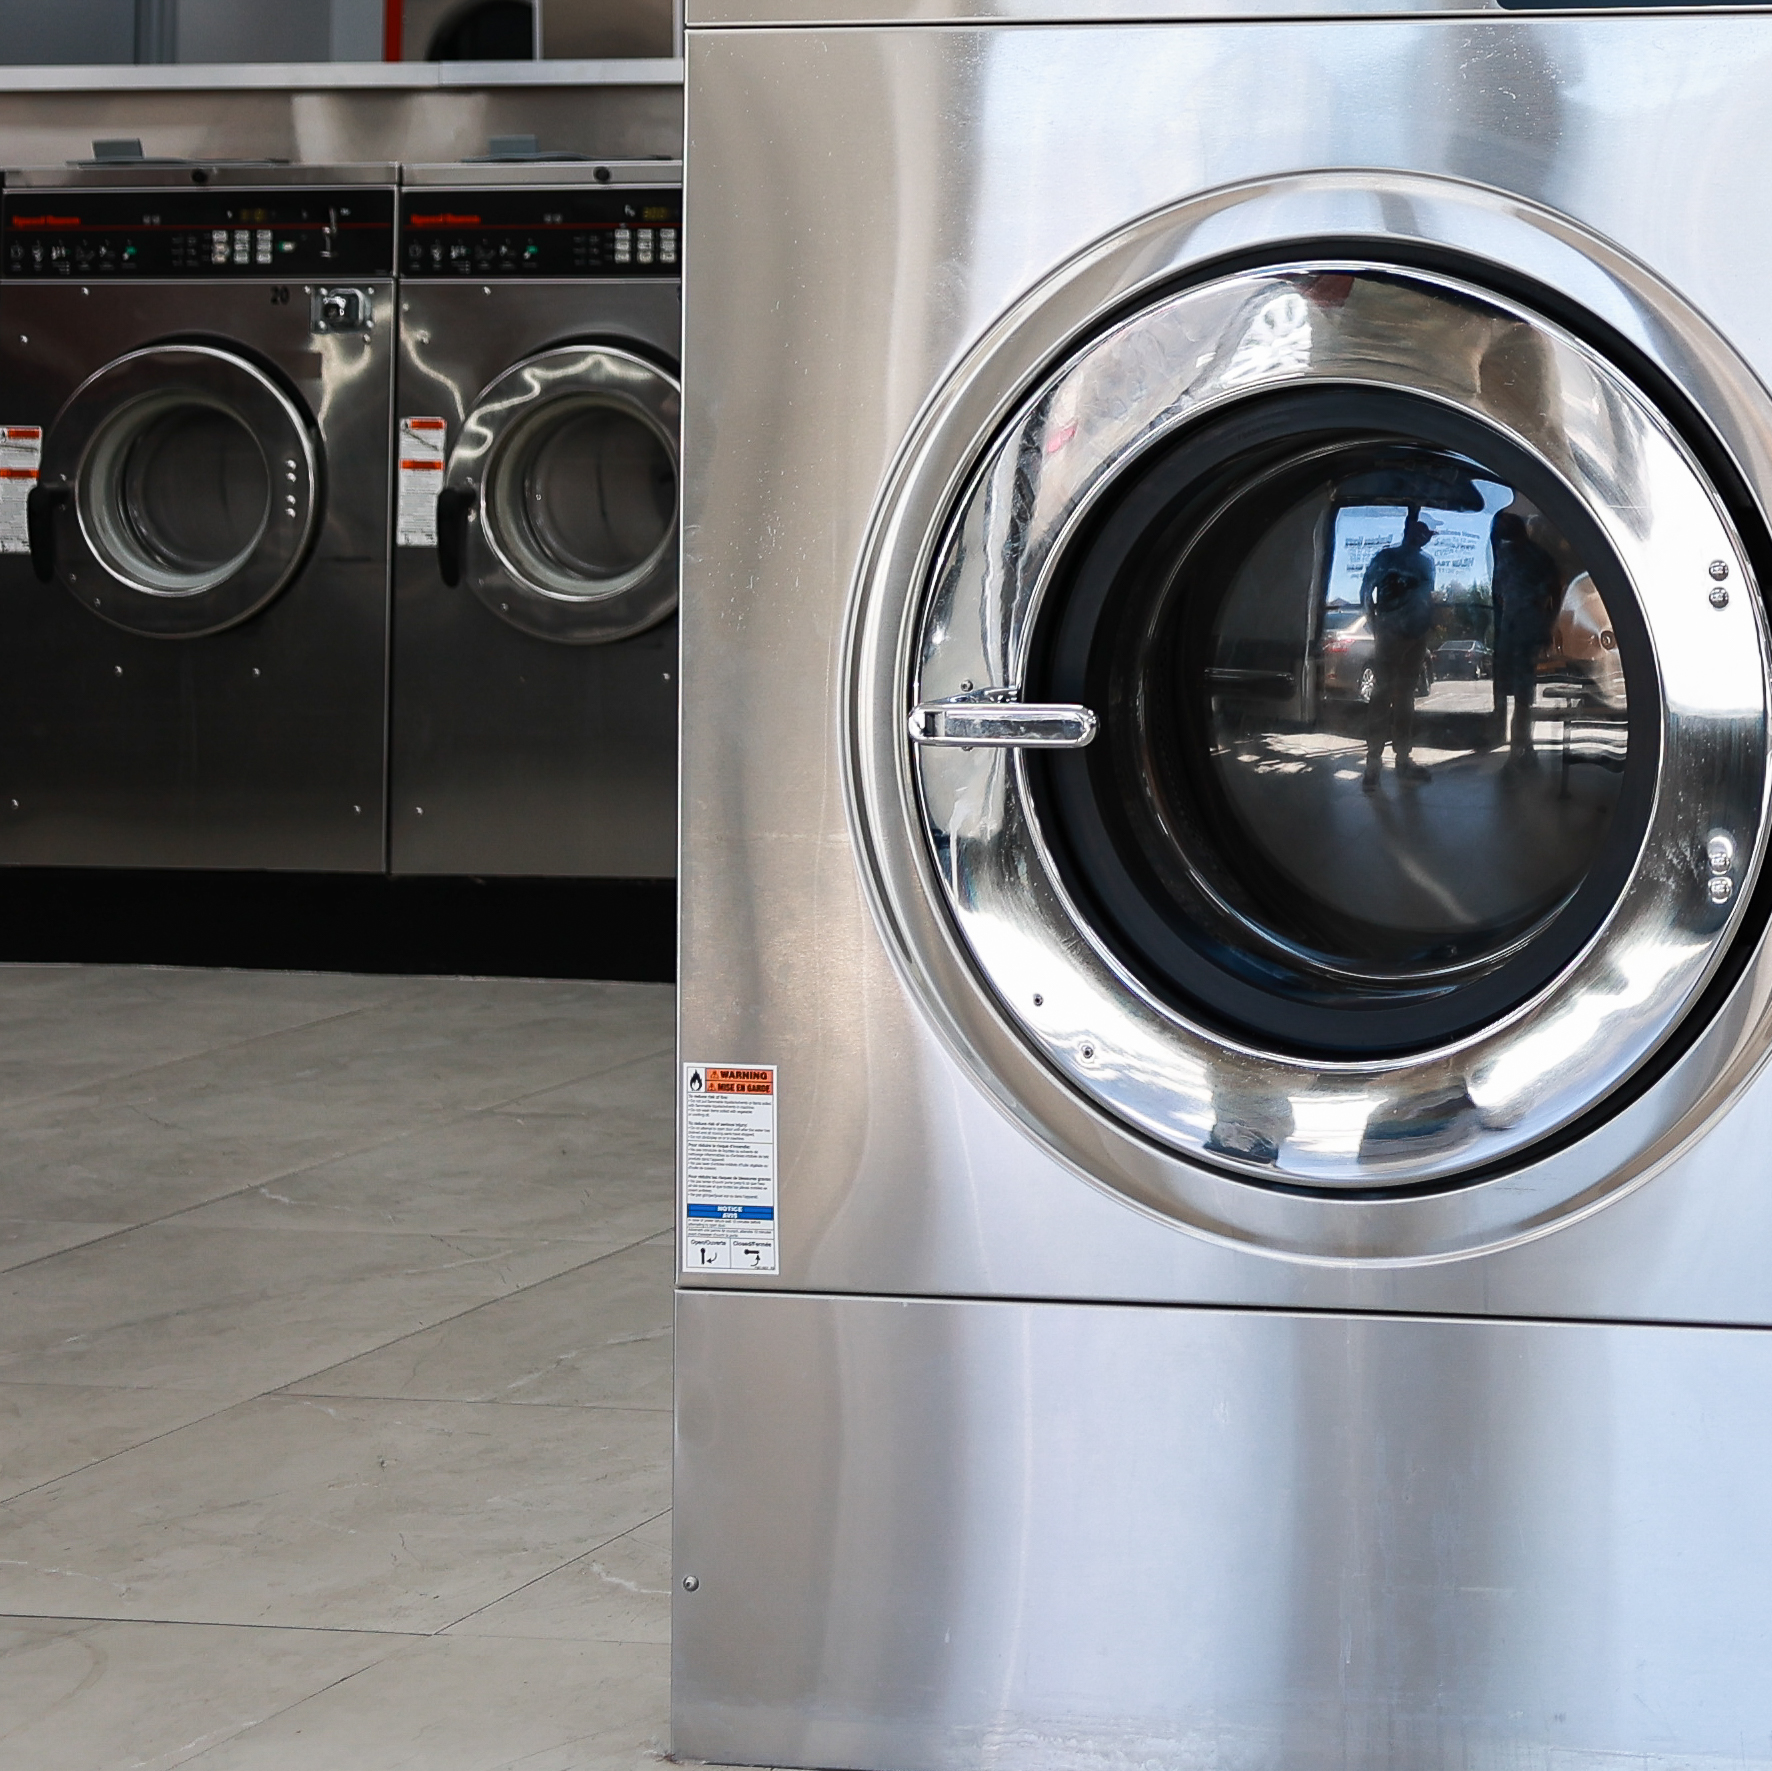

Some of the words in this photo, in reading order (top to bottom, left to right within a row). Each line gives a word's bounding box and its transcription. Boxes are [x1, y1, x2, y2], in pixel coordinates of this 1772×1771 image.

[719, 1070, 768, 1080] WARNING
[717, 1082, 735, 1092] MISE
[736, 1083, 746, 1092] EN
[747, 1084, 771, 1093] GARDE
